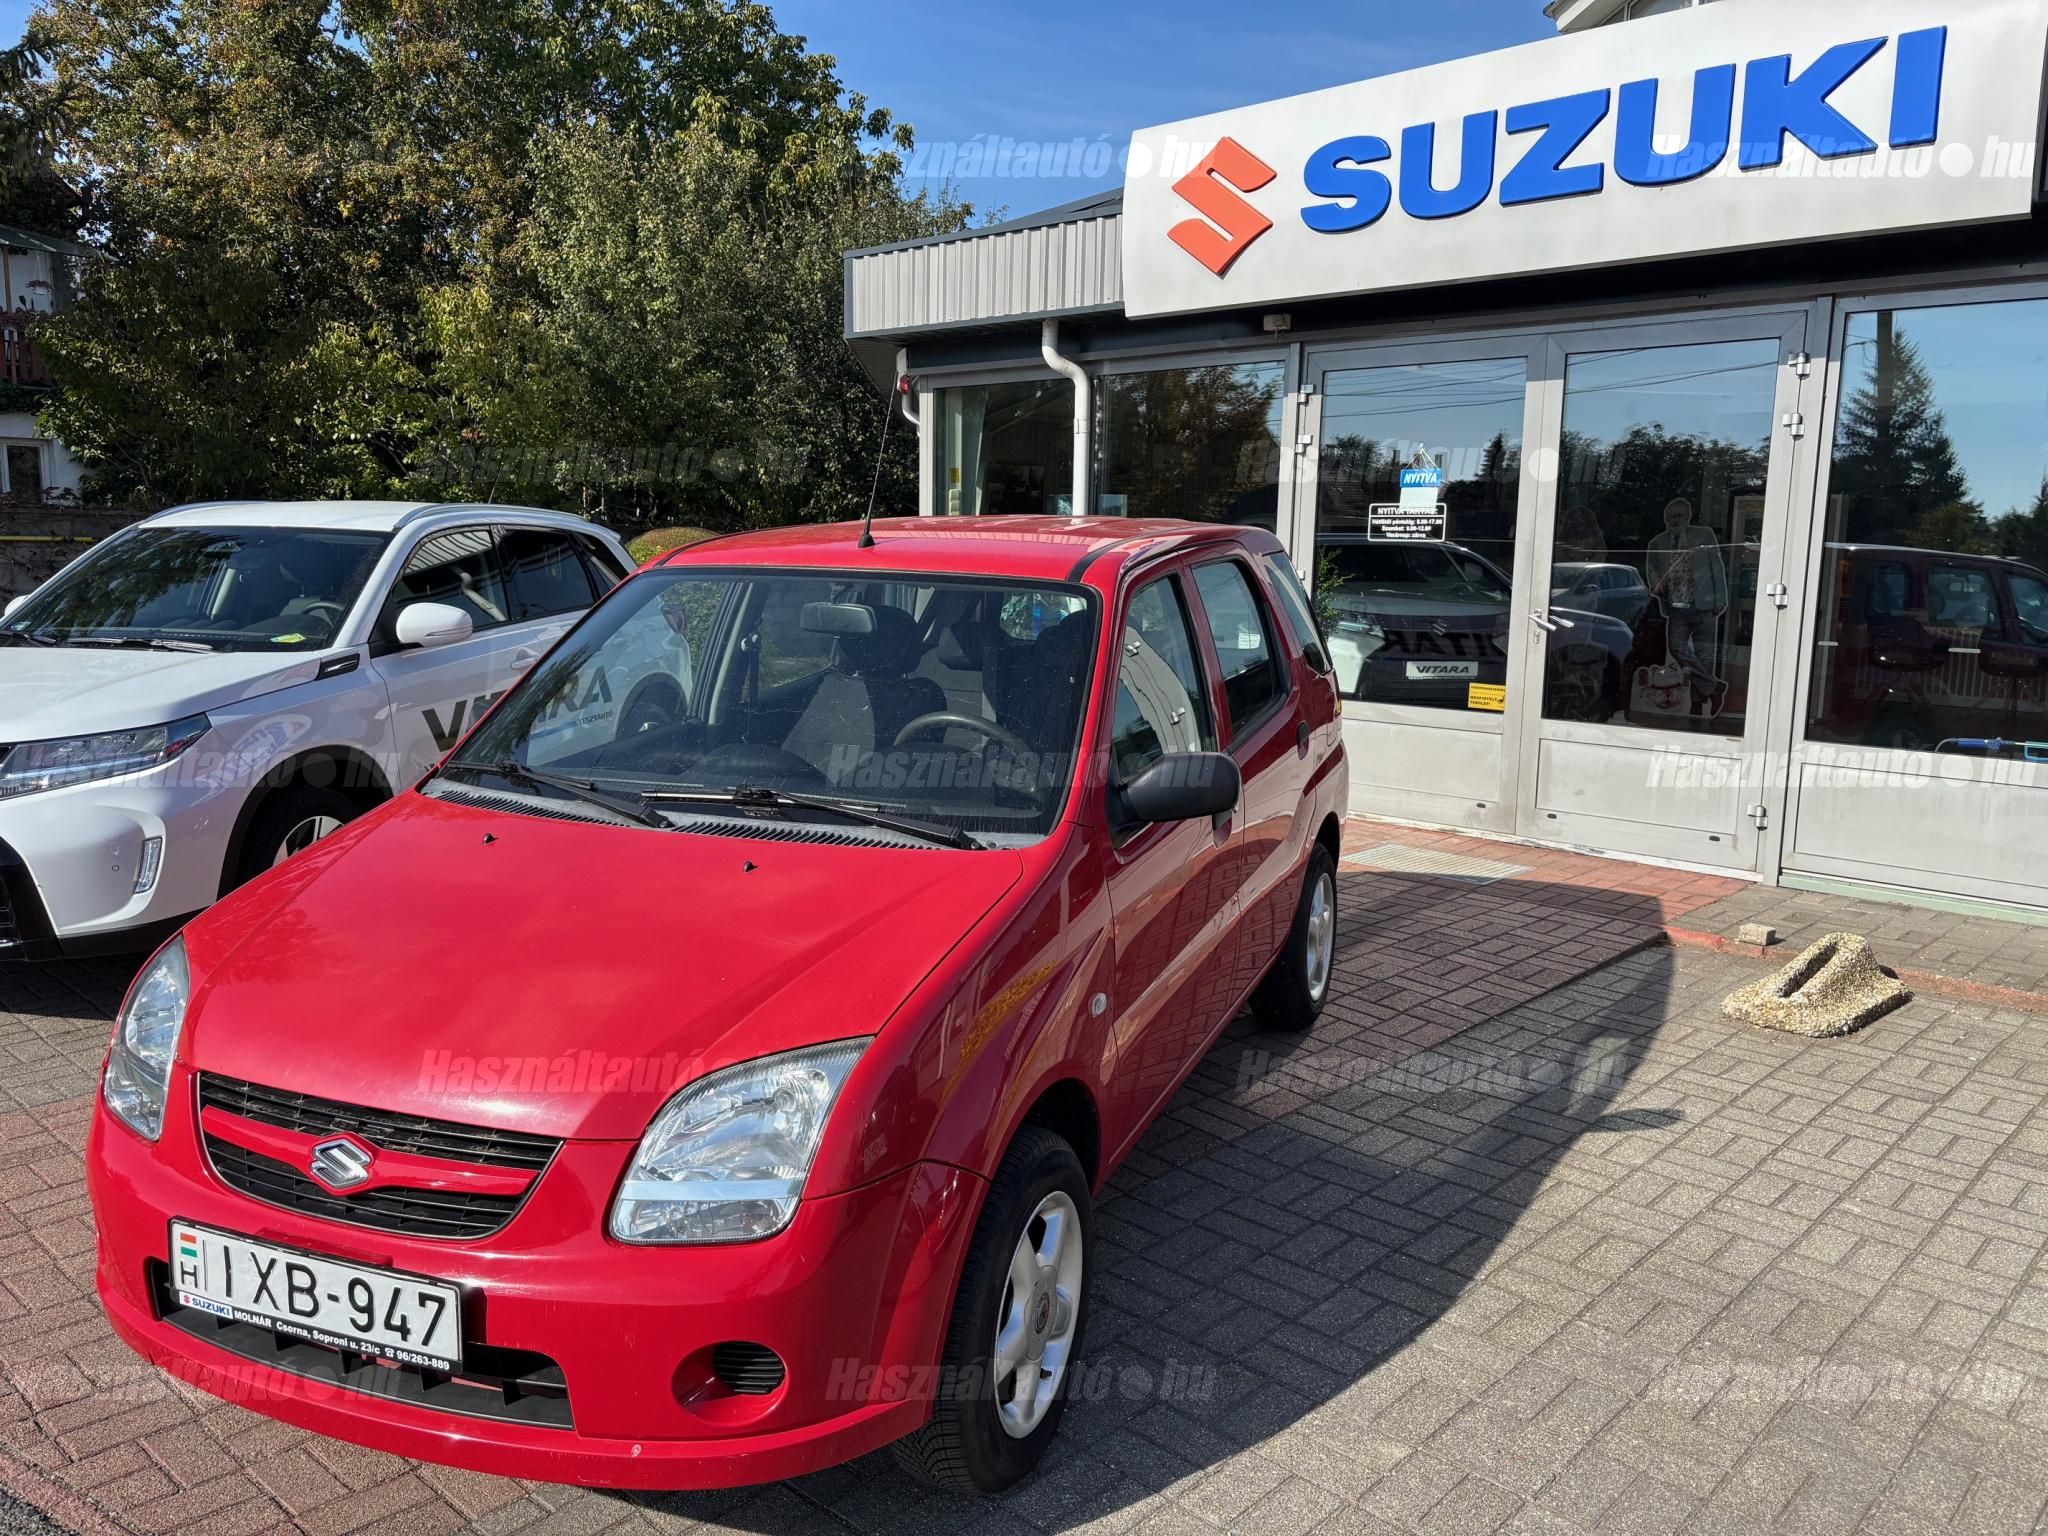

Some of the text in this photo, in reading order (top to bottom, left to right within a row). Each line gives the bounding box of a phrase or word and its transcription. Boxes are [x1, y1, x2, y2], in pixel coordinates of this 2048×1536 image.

[1300, 25, 1948, 234] SUZUKI
[1403, 472, 1437, 484] NYITVA
[1415, 665, 1470, 674] VITARA
[179, 1261, 199, 1289] H
[191, 1296, 451, 1372] SUZUKI MOLNÁR Csorna, Soproni u. 23/c 96/263-889
